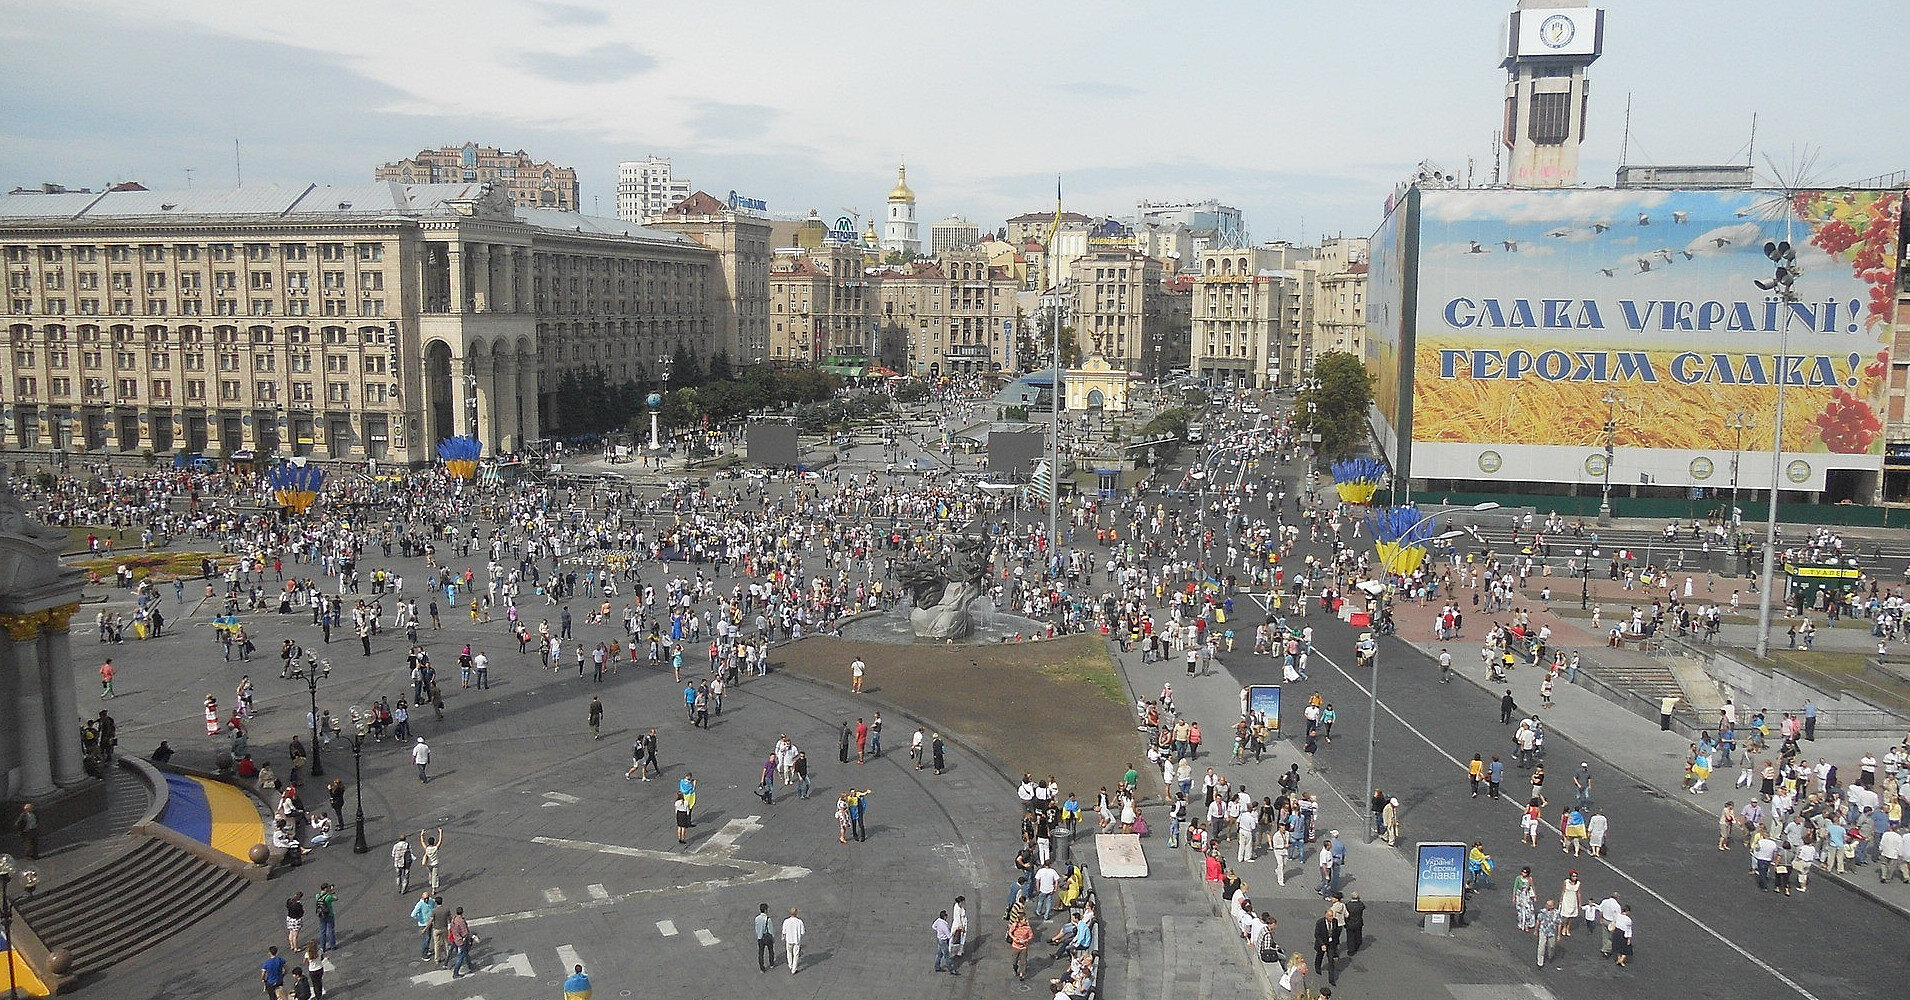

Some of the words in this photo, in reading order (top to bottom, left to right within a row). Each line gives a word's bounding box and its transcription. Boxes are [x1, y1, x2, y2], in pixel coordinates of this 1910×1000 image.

[1443, 297, 1606, 331] СЛАВА
[1438, 349, 1659, 383] ГЕРОЯМ
[1422, 869, 1460, 880] Слава!
